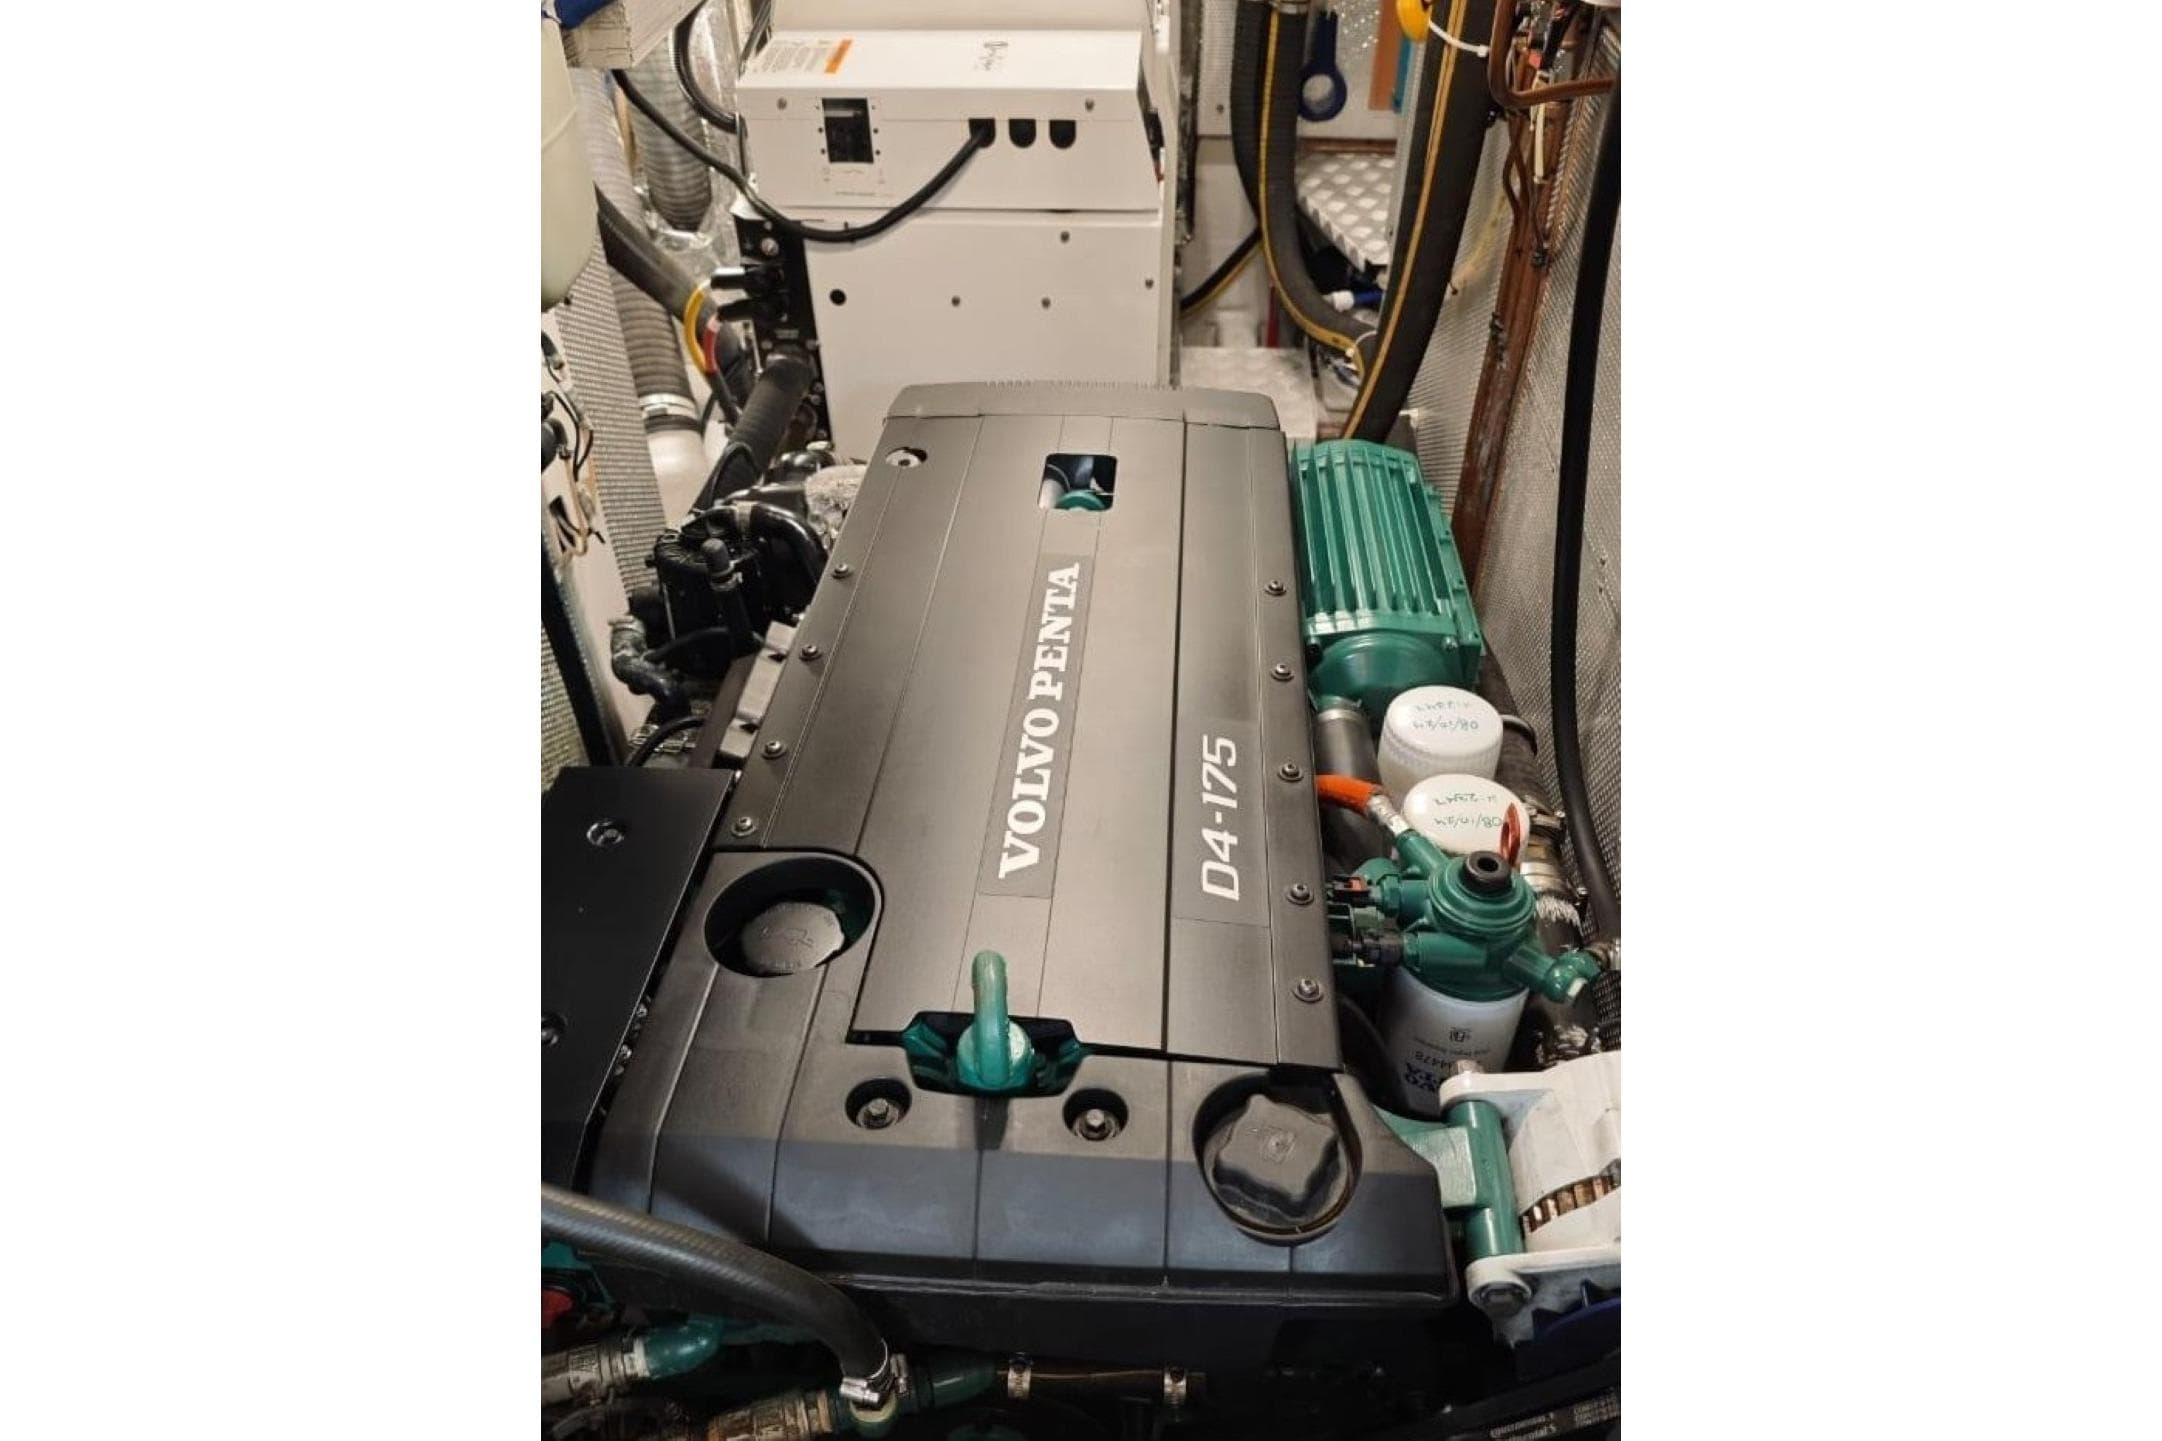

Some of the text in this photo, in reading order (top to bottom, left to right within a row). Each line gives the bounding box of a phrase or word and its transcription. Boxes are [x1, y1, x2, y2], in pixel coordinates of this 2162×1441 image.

[998, 562, 1080, 879] VOLVO PENTA
[1201, 734, 1240, 901] D4-175
